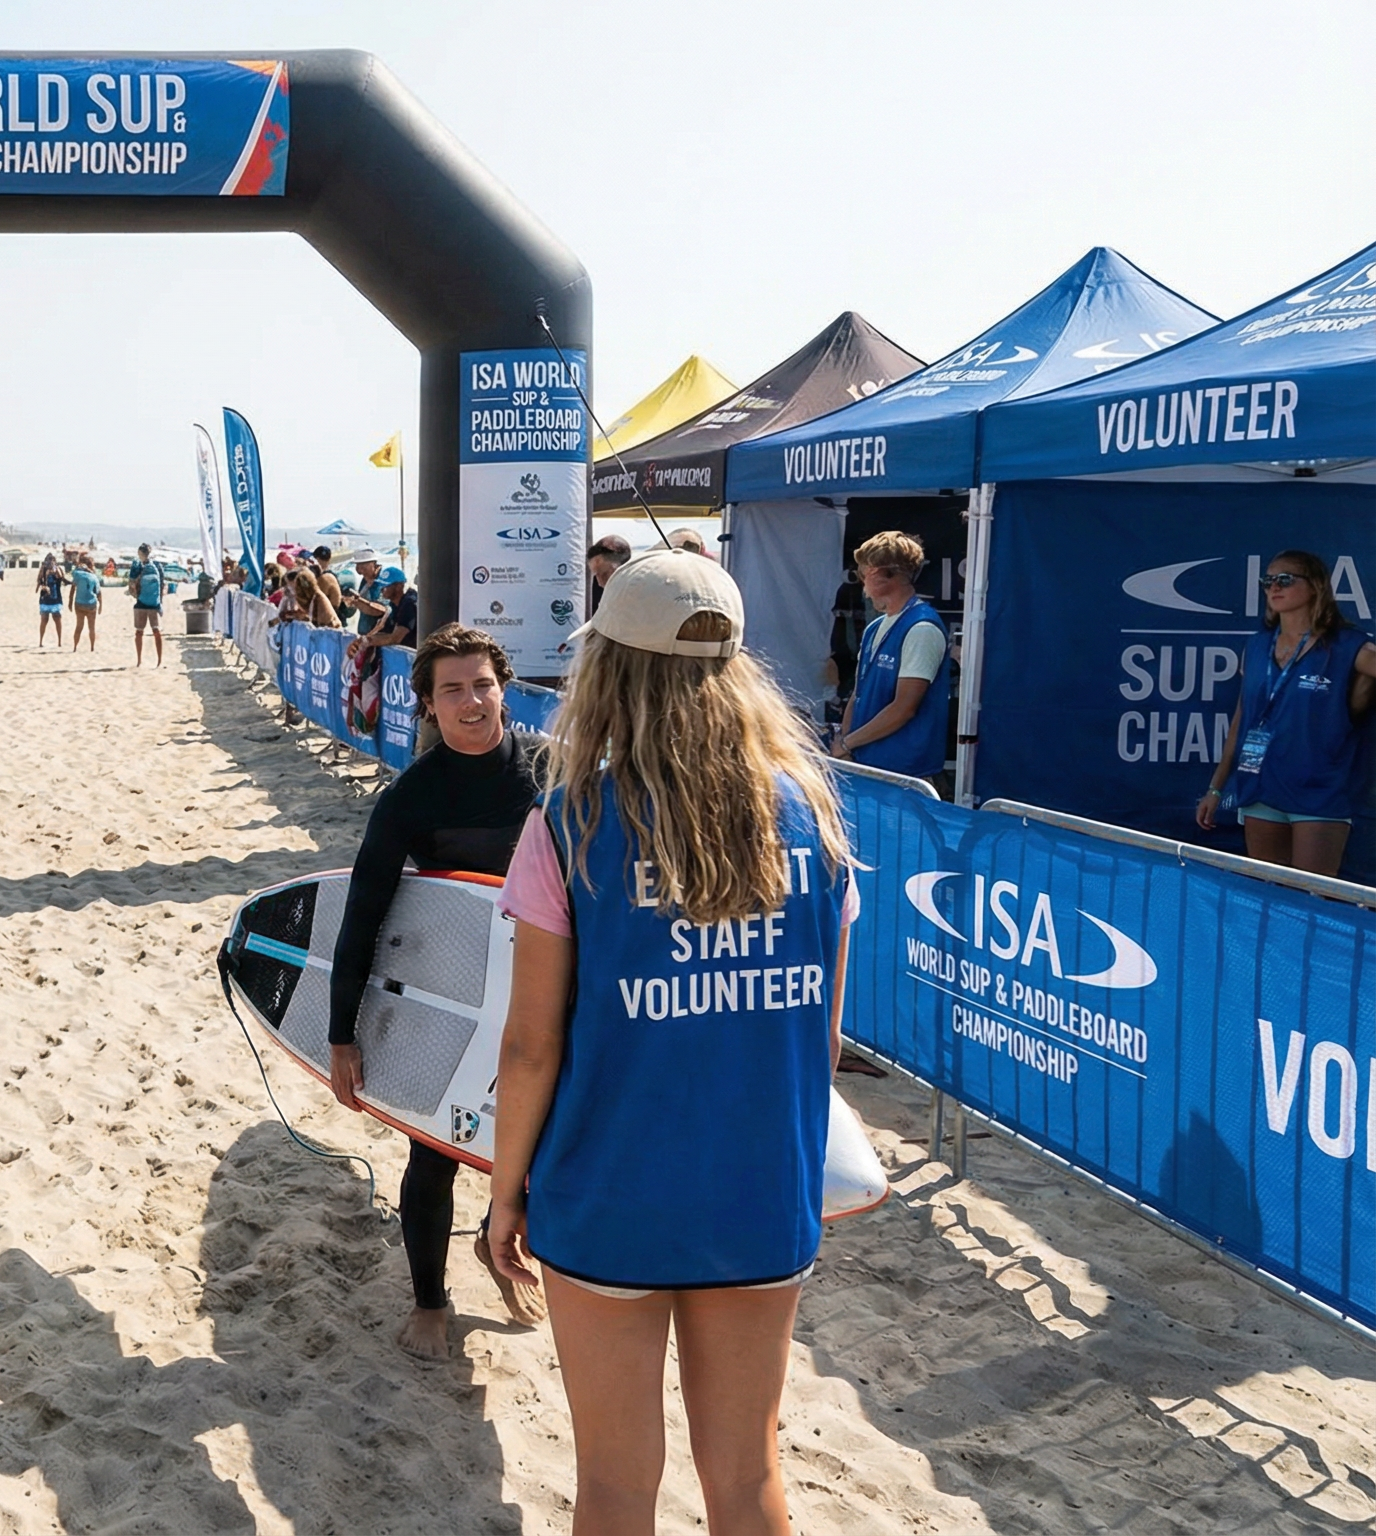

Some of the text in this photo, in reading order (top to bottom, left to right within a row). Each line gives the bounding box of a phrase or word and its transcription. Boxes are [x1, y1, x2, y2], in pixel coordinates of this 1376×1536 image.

[86, 74, 187, 134] SUP
[173, 111, 187, 134] &
[472, 361, 581, 391] ISA WORLD
[512, 392, 550, 406] SUP &
[471, 408, 581, 431] PADDLEBOARD
[471, 430, 581, 452] CHAMPIONSHIP
[1098, 380, 1298, 454] VOLUNTEER
[783, 436, 886, 484] VOLUNTEER
[518, 527, 541, 540] ISA
[1246, 555, 1372, 619] IA
[1119, 644, 1239, 701] SUP
[670, 911, 785, 963] STAFF
[975, 874, 1062, 979] ISA
[618, 964, 823, 1021] VOLUNTEER
[906, 936, 1147, 1063] WORLD SUP & PADDLEBOARD
[952, 1004, 1079, 1085] CHAMPIONSHIP
